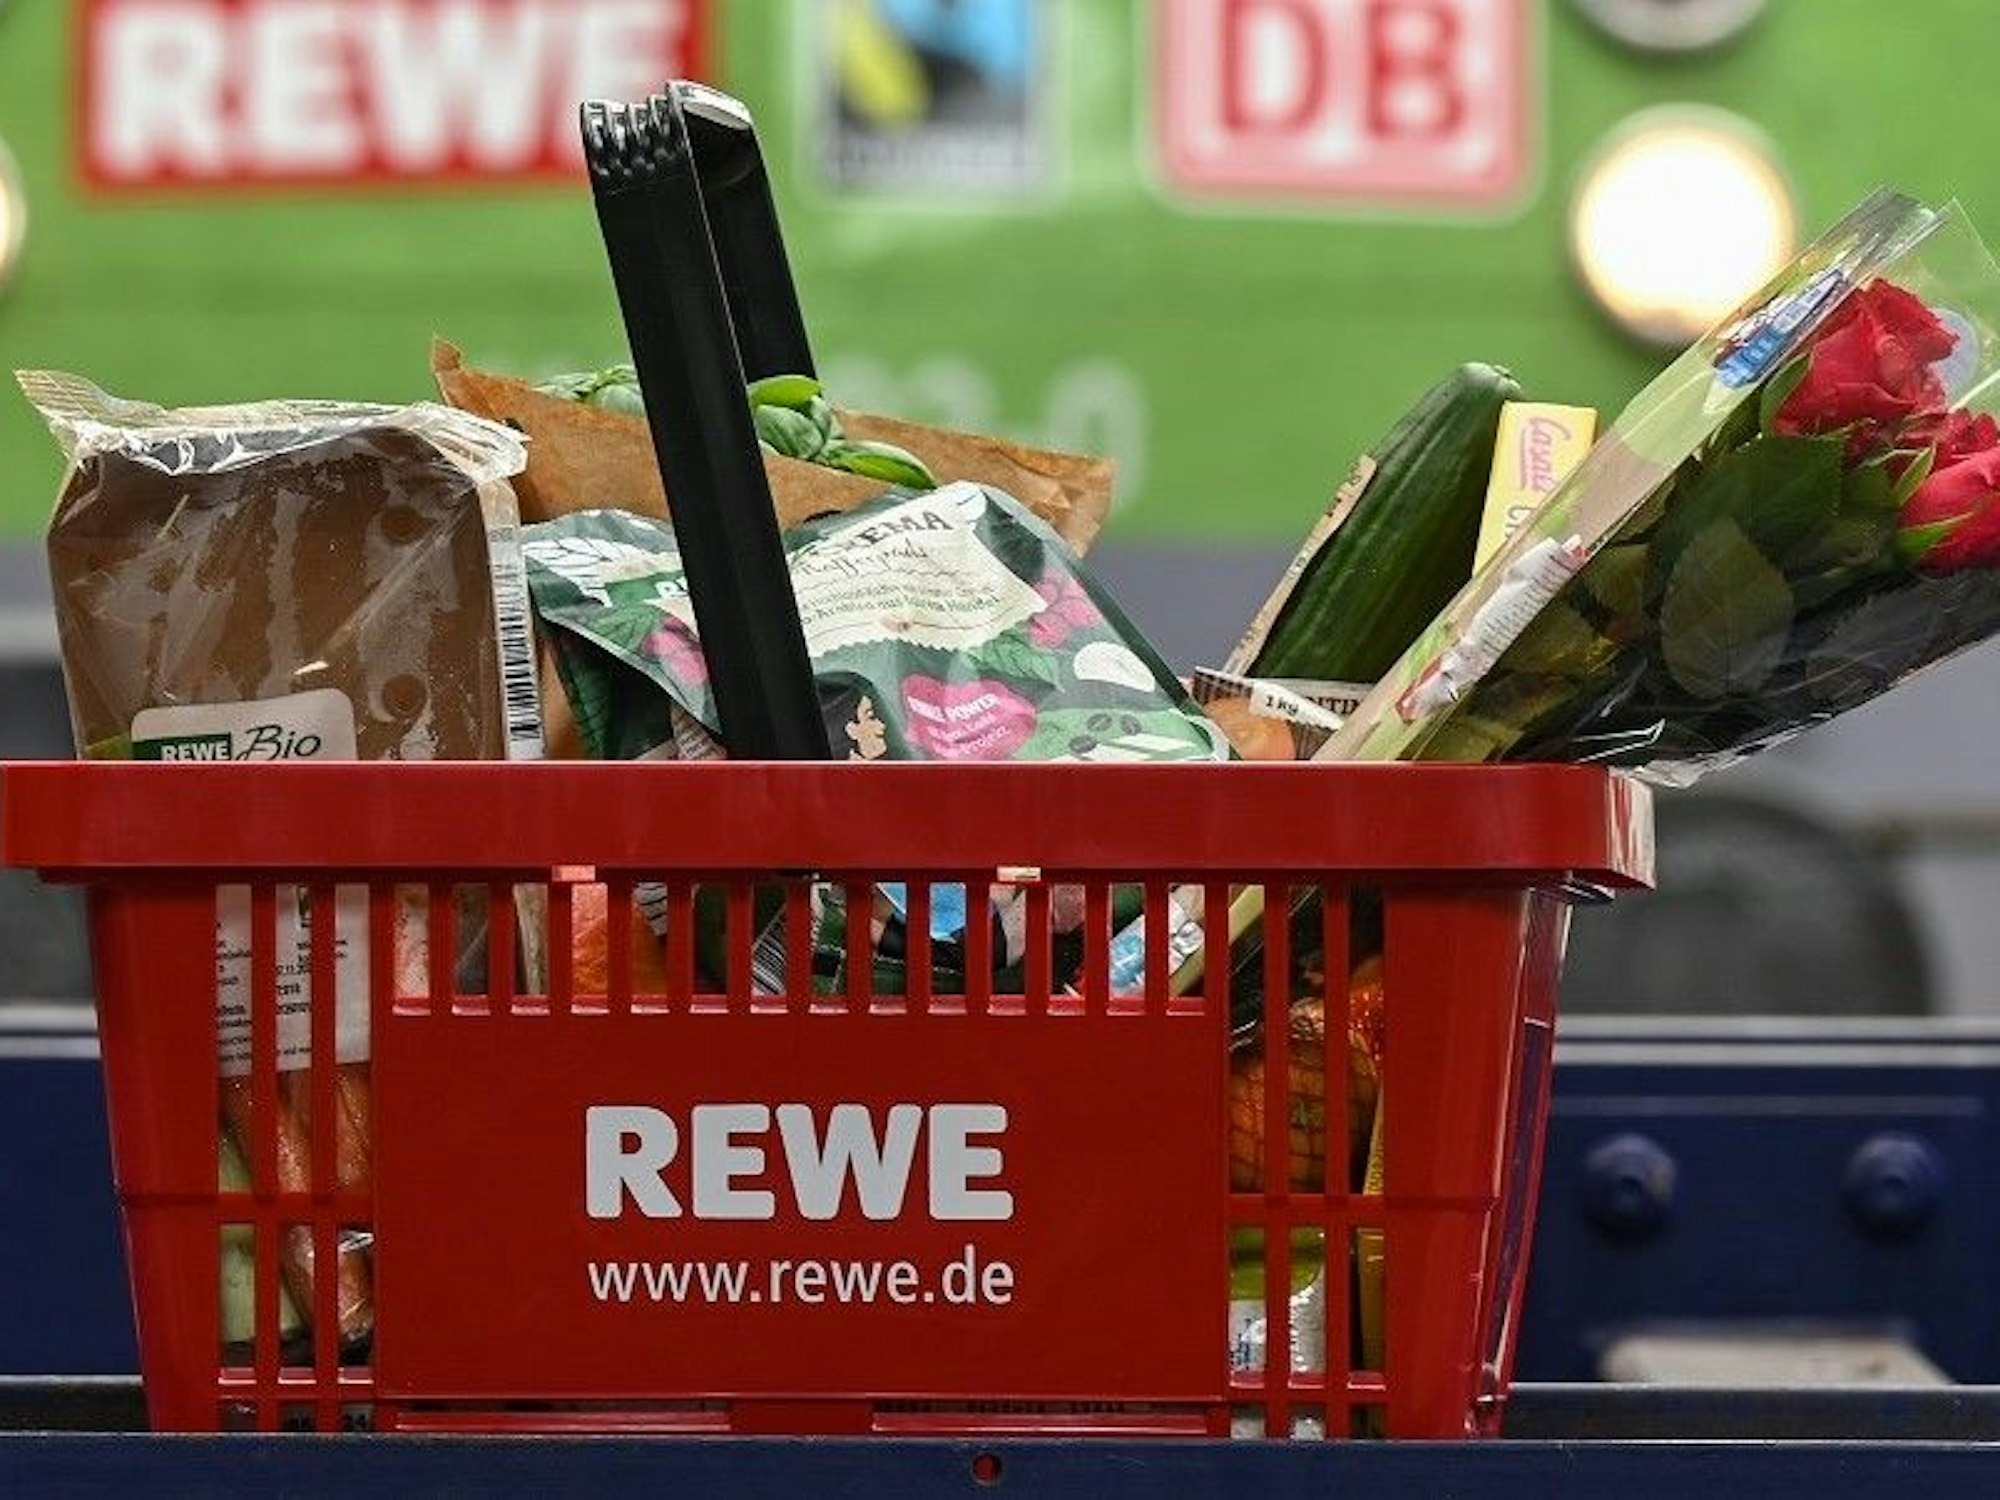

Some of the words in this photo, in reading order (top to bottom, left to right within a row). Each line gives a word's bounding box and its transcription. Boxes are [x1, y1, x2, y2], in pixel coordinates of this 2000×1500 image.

[98, 0, 690, 178] REWE
[1220, 0, 1468, 140] DB
[160, 740, 231, 760] REWE
[235, 724, 322, 760] Bio
[585, 1103, 1015, 1220] REWE
[587, 1243, 1015, 1304] www.rewe.de
